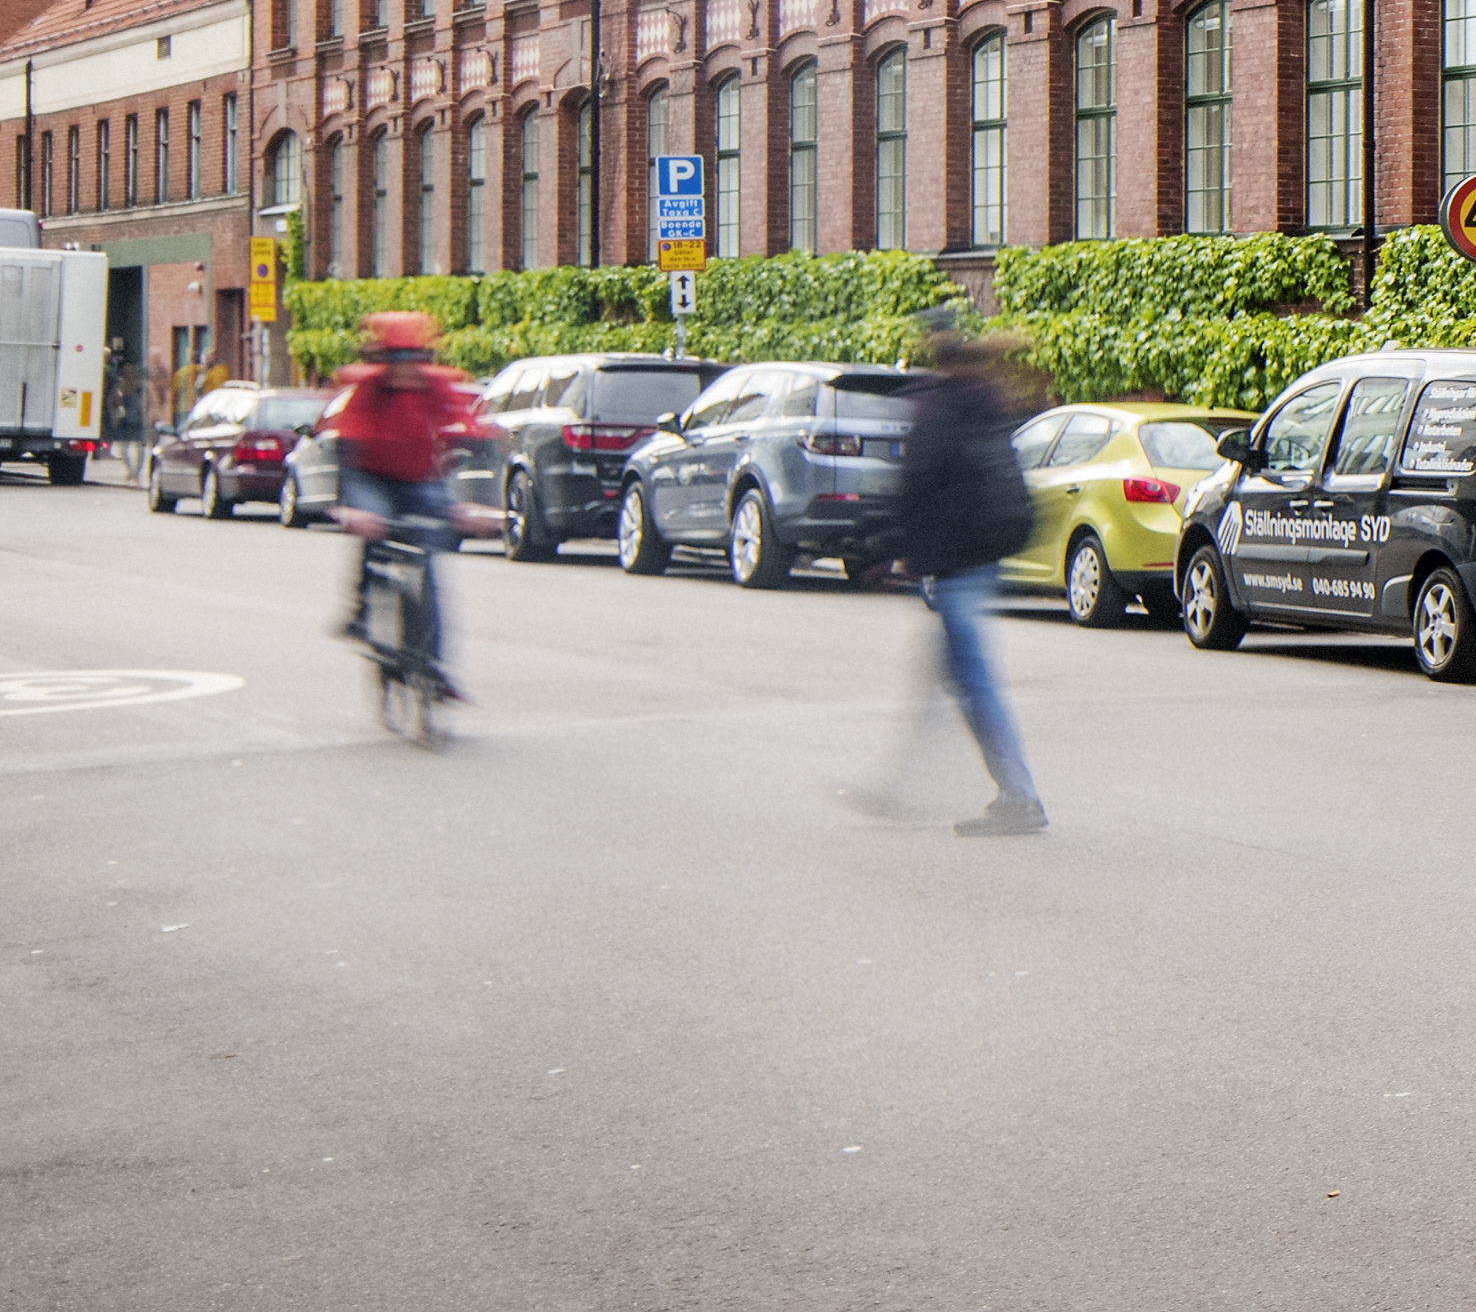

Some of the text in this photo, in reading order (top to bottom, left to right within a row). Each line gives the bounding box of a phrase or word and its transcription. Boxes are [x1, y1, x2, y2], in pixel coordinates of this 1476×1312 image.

[669, 159, 695, 193] P
[662, 208, 700, 216] Taxa C
[664, 199, 698, 209] Avgift
[661, 220, 702, 229] Boende
[668, 229, 695, 237] GK-C
[1244, 508, 1391, 548] Ställningsmontage SYD
[1243, 572, 1303, 594] www.smsyd.se
[1312, 577, 1376, 600] 040-685 94 90
